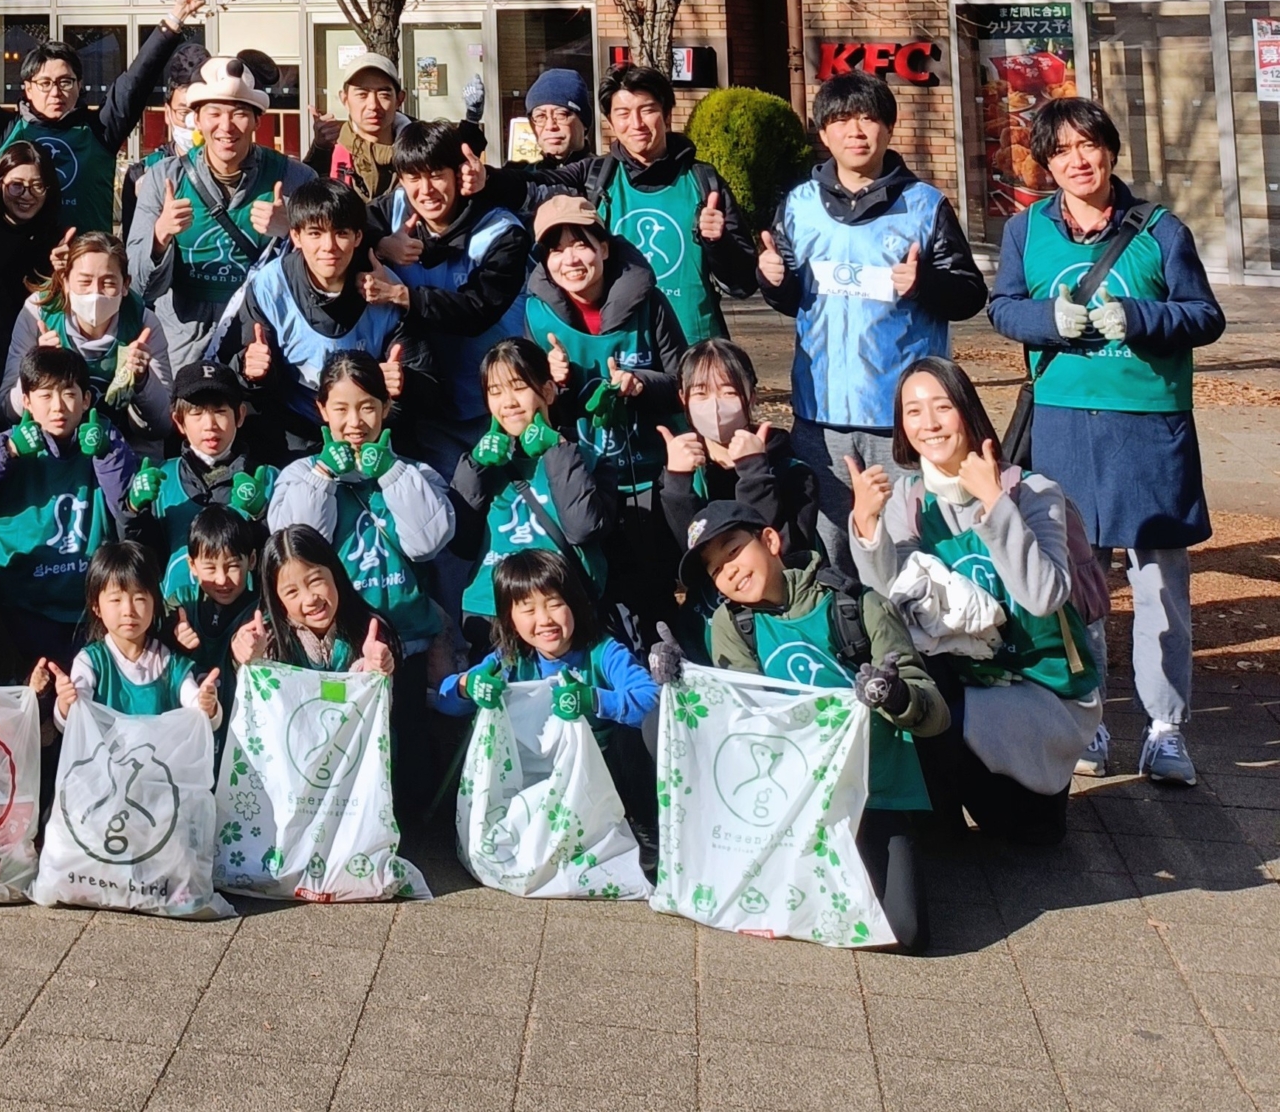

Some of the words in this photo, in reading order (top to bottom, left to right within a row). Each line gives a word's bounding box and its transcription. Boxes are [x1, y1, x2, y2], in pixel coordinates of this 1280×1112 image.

[816, 41, 932, 82] KFC
[1260, 45, 1280, 65] 募
[61, 198, 77, 206] ird
[231, 274, 243, 282] bi
[660, 287, 681, 297] ird
[615, 350, 652, 366] UACJ
[202, 365, 215, 378] P
[33, 561, 76, 577] green
[353, 578, 379, 591] een
[712, 824, 762, 845] green
[68, 871, 119, 889] green
[129, 878, 169, 897] bird
